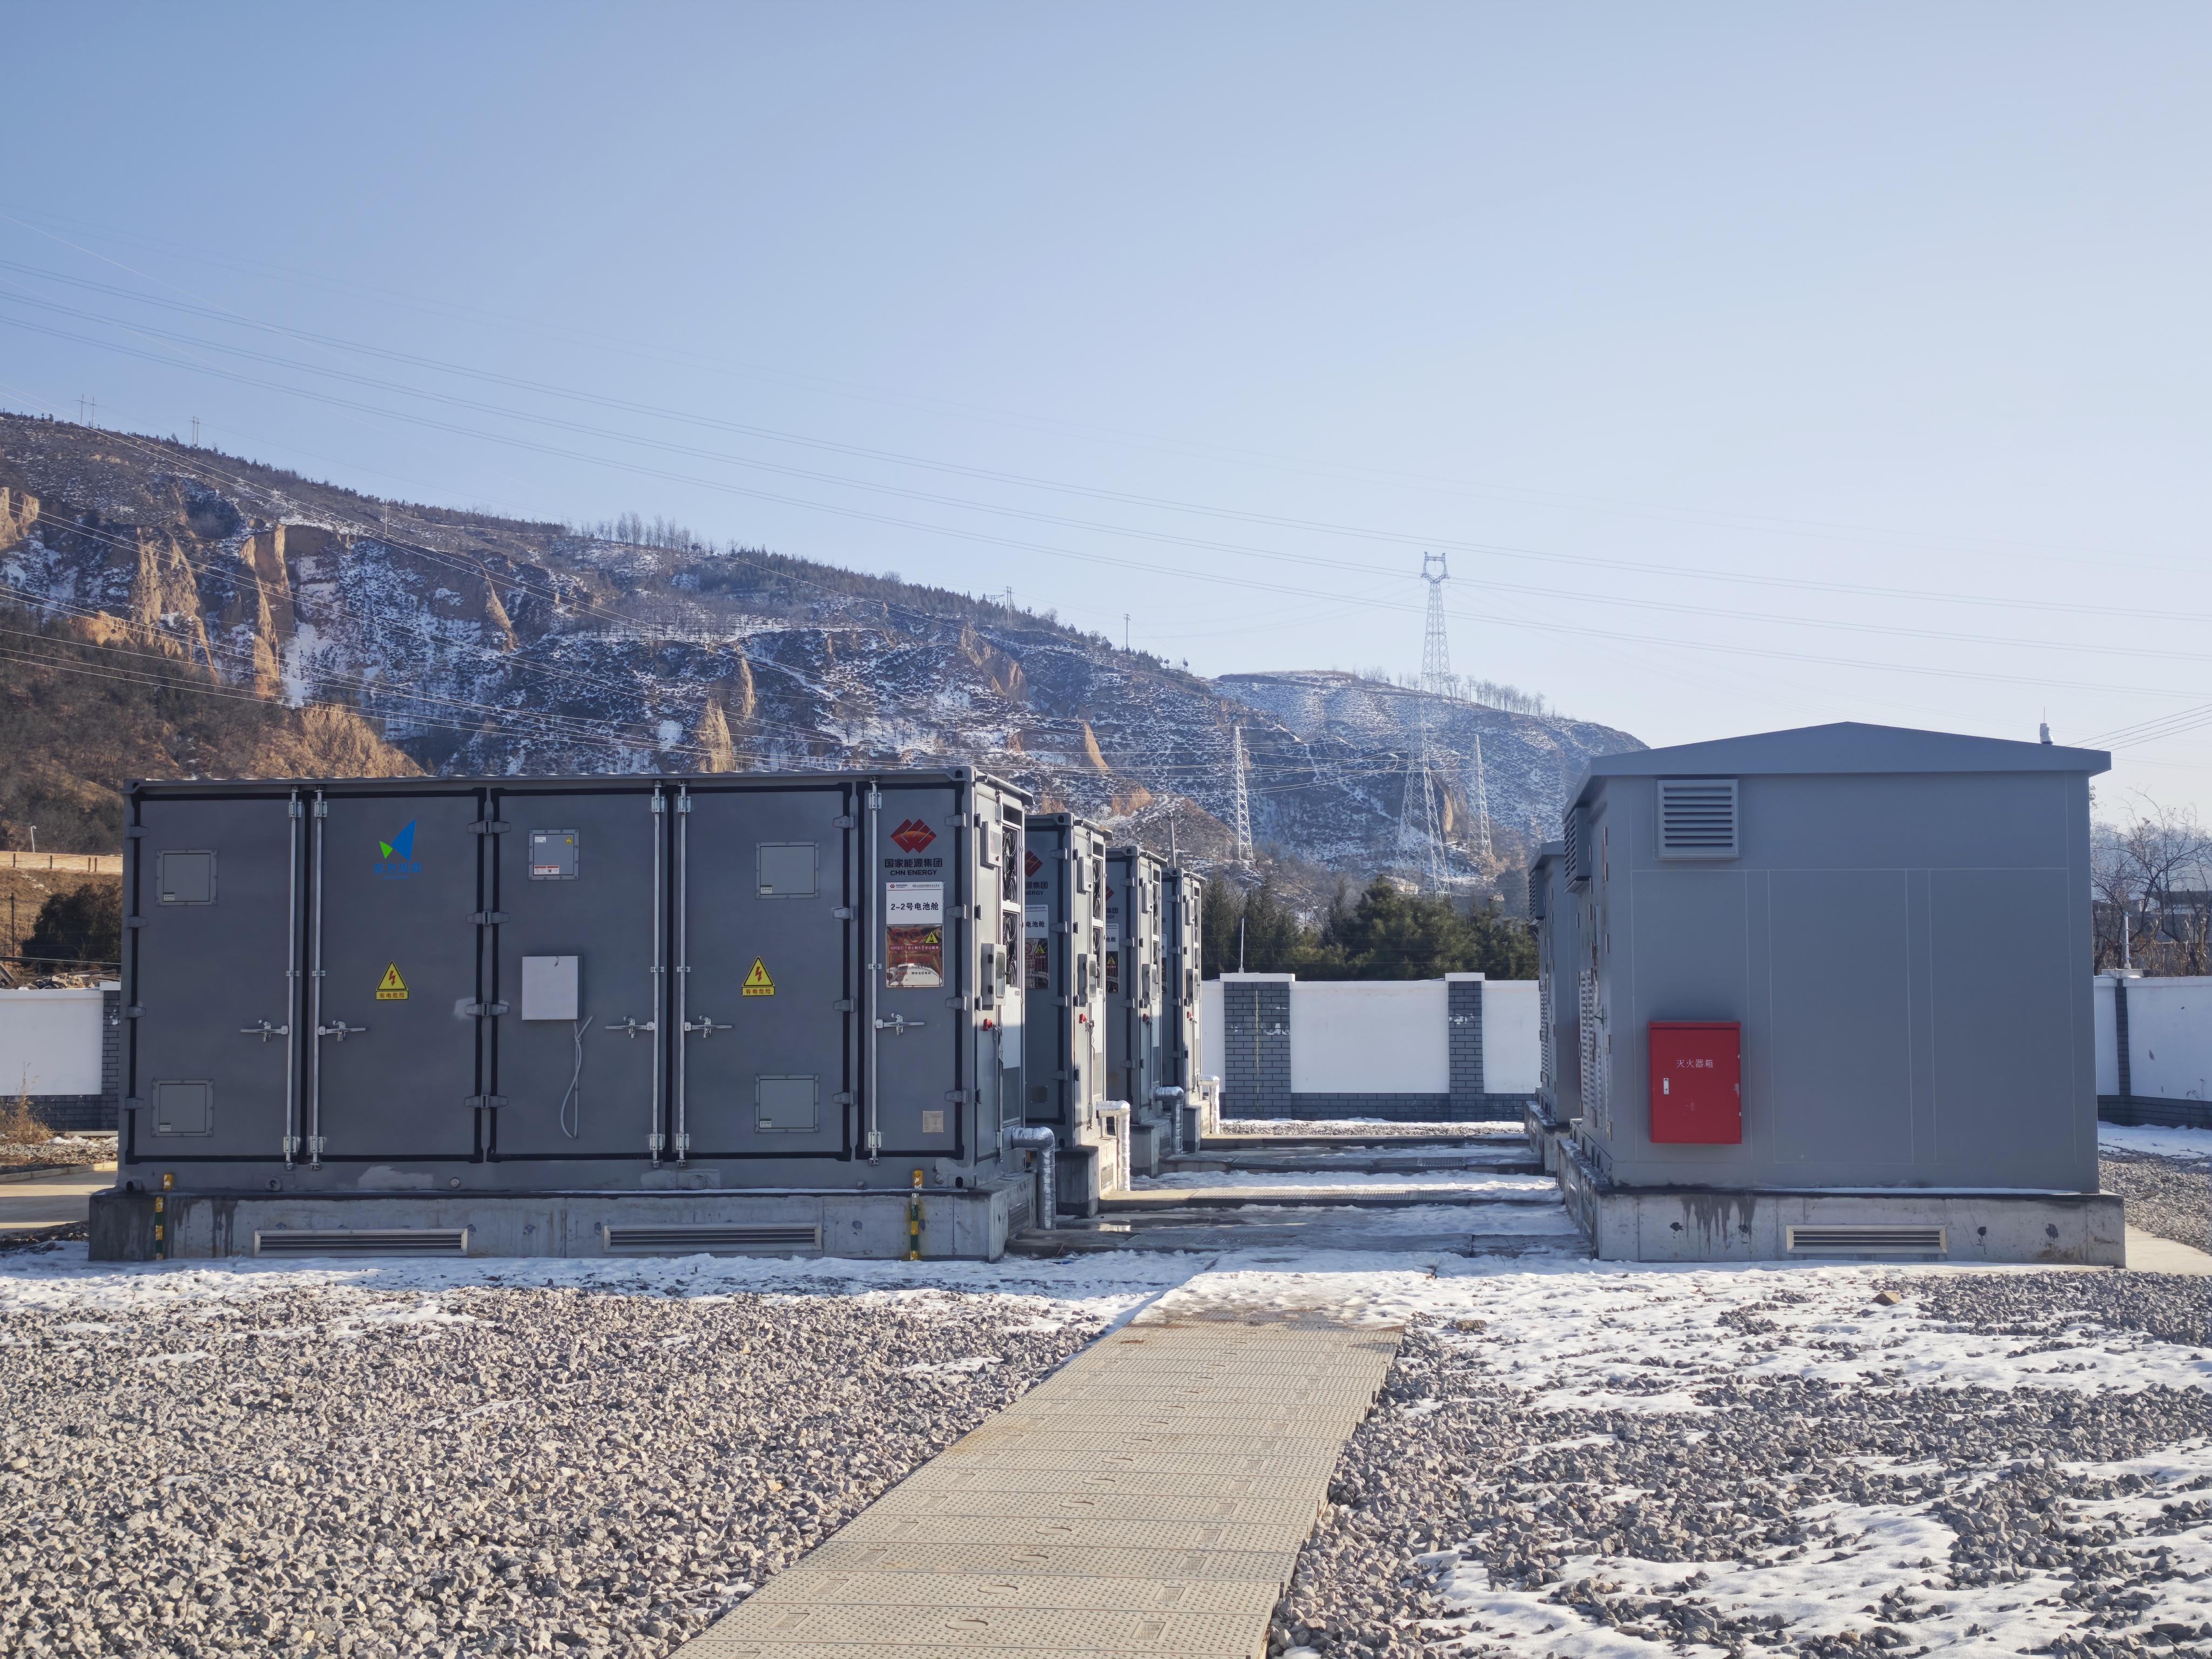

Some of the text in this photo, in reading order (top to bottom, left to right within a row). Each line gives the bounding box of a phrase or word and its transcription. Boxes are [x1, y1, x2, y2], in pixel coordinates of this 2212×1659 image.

[885, 858, 942, 868] 国家能源集团
[891, 902, 939, 911] 2-2号电池舱
[1676, 1059, 1714, 1068] 灭火器箱
